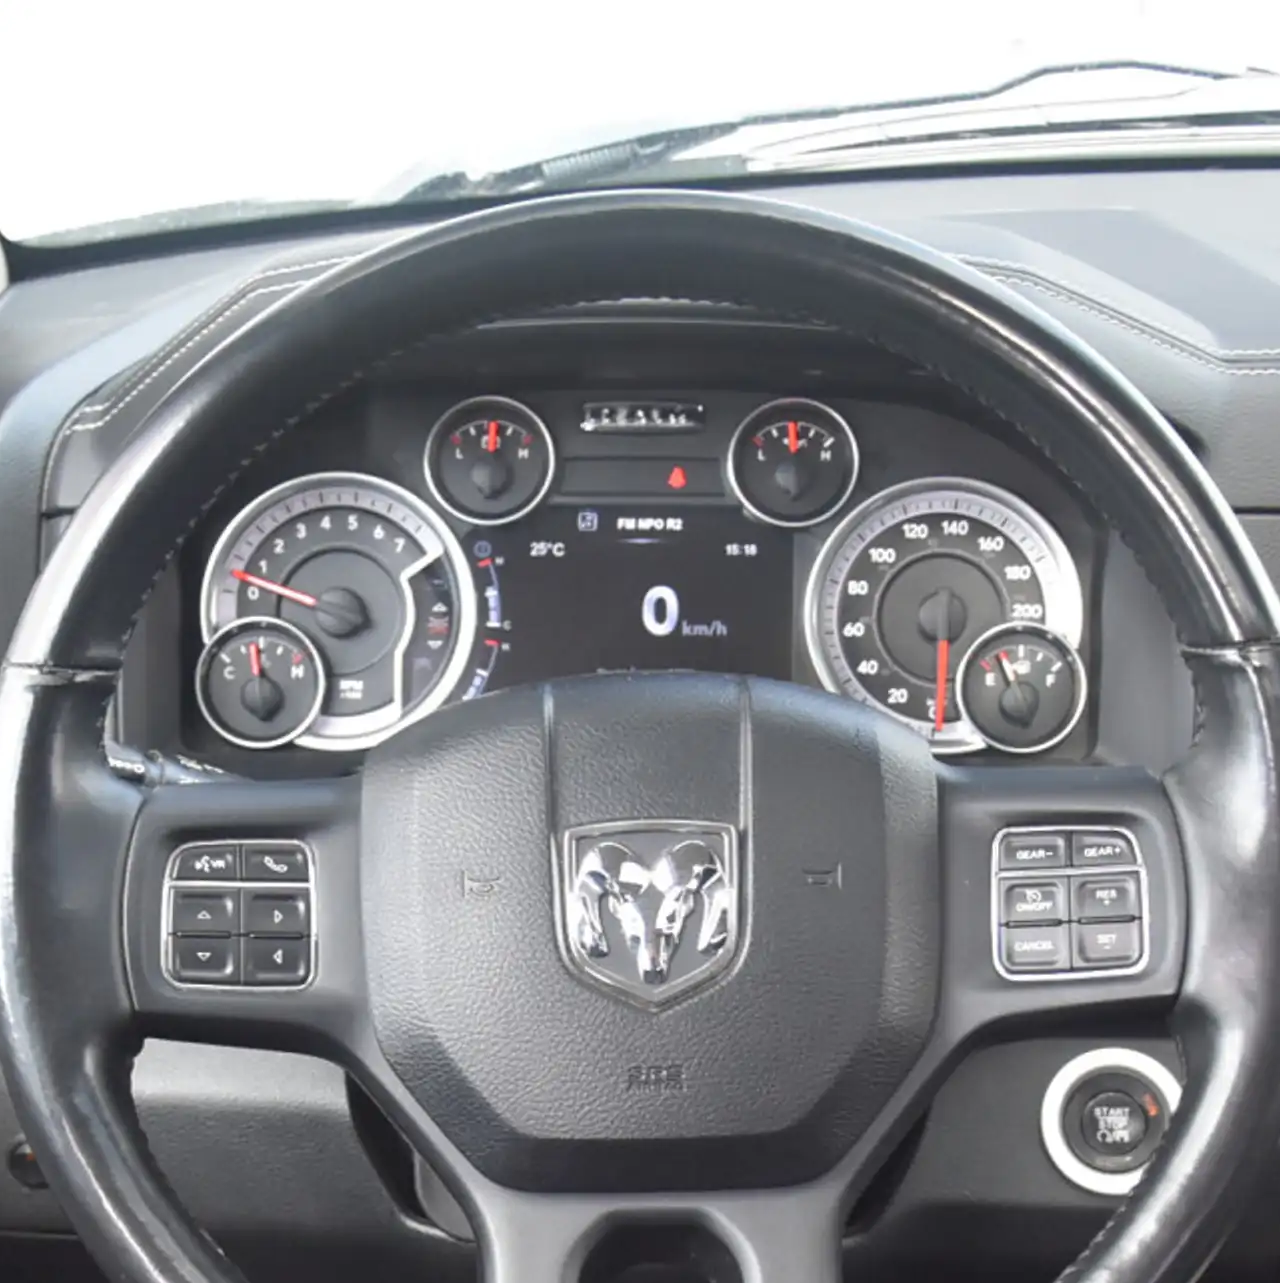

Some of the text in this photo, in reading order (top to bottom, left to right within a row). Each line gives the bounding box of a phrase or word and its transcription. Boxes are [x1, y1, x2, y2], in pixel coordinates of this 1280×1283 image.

[320, 515, 331, 530] 4
[348, 515, 358, 530] 5
[942, 521, 968, 535] 140
[297, 524, 307, 538] 3
[373, 525, 385, 539] 6
[903, 524, 928, 539] 120
[273, 539, 285, 553] 2
[394, 538, 405, 553] 7
[978, 537, 1003, 552] 160
[869, 549, 895, 563] 100
[259, 560, 267, 573] 1
[1004, 566, 1031, 580] 180
[247, 587, 259, 601] 0
[848, 581, 868, 596] 80
[642, 585, 727, 636] 0 km/h
[1012, 604, 1042, 619] 200
[843, 623, 864, 637] 60
[223, 667, 235, 680] C
[291, 666, 303, 679] H
[857, 660, 877, 675] 40
[986, 673, 995, 686] E
[1046, 673, 1056, 686] F
[888, 689, 907, 704] 20
